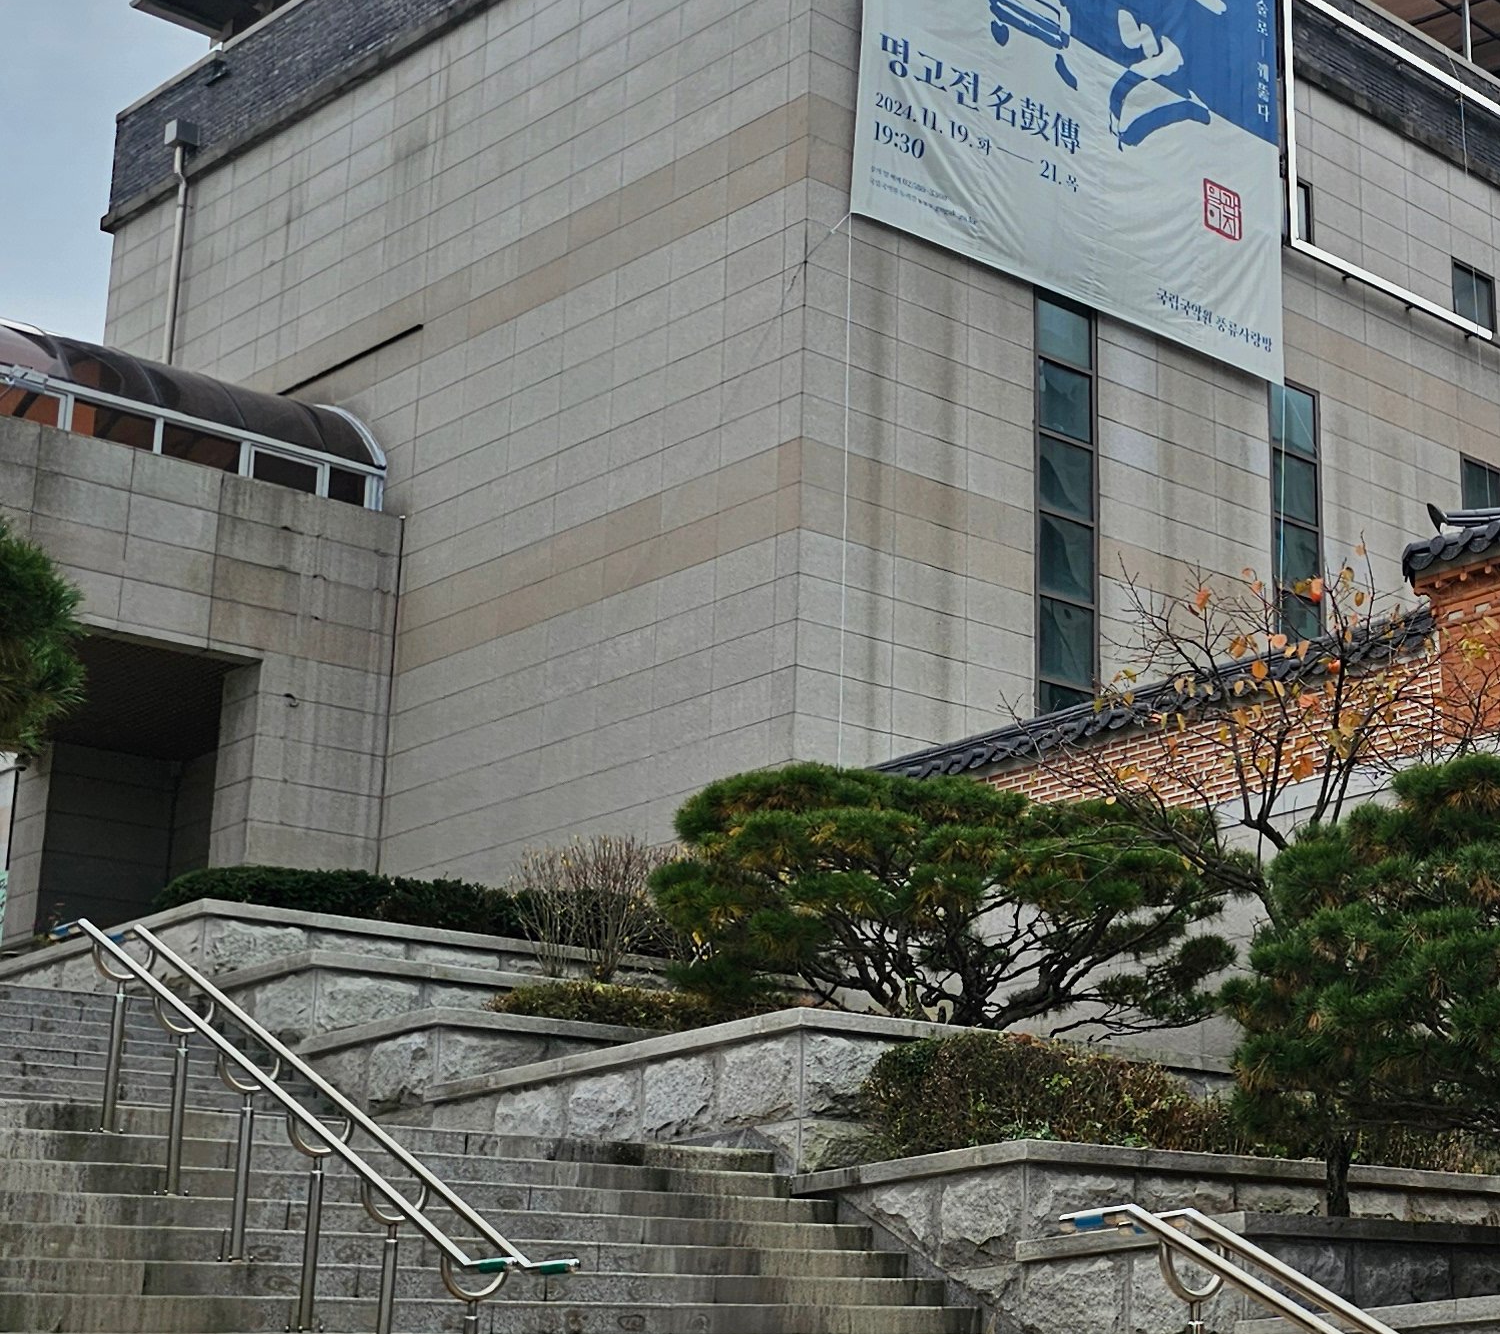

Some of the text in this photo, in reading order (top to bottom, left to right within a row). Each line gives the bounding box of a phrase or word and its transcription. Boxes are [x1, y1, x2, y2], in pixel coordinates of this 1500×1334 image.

[879, 33, 1081, 155] 명고전 名鼓傳
[874, 121, 925, 159] 19:30
[1156, 287, 1273, 353] 국립국악원 풍류사랑방
